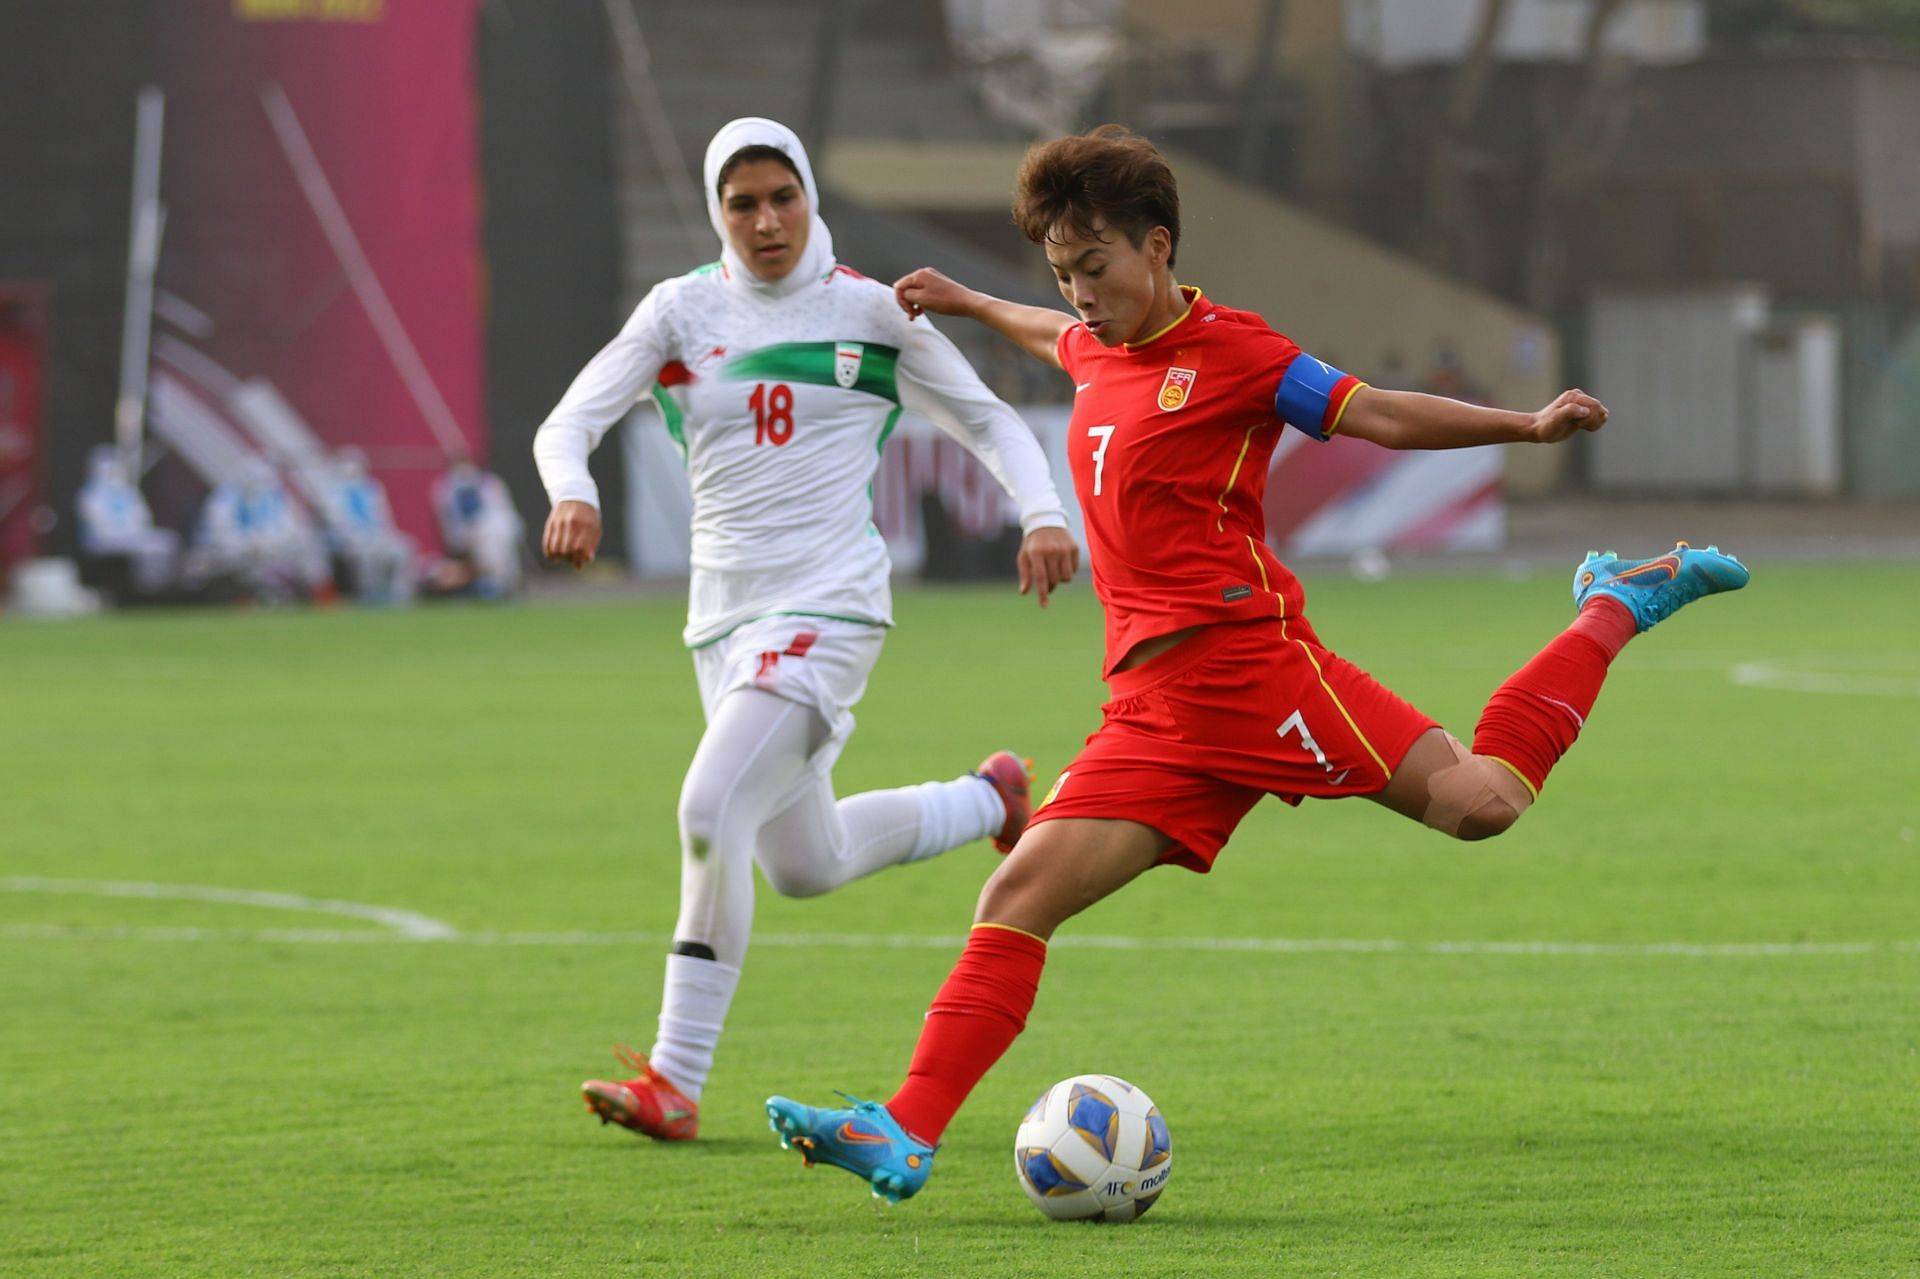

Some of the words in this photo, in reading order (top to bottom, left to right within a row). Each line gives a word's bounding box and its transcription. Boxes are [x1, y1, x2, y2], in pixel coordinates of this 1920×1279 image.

[749, 384, 794, 447] 18
[1088, 425, 1116, 496] 7
[1276, 709, 1334, 772] 7
